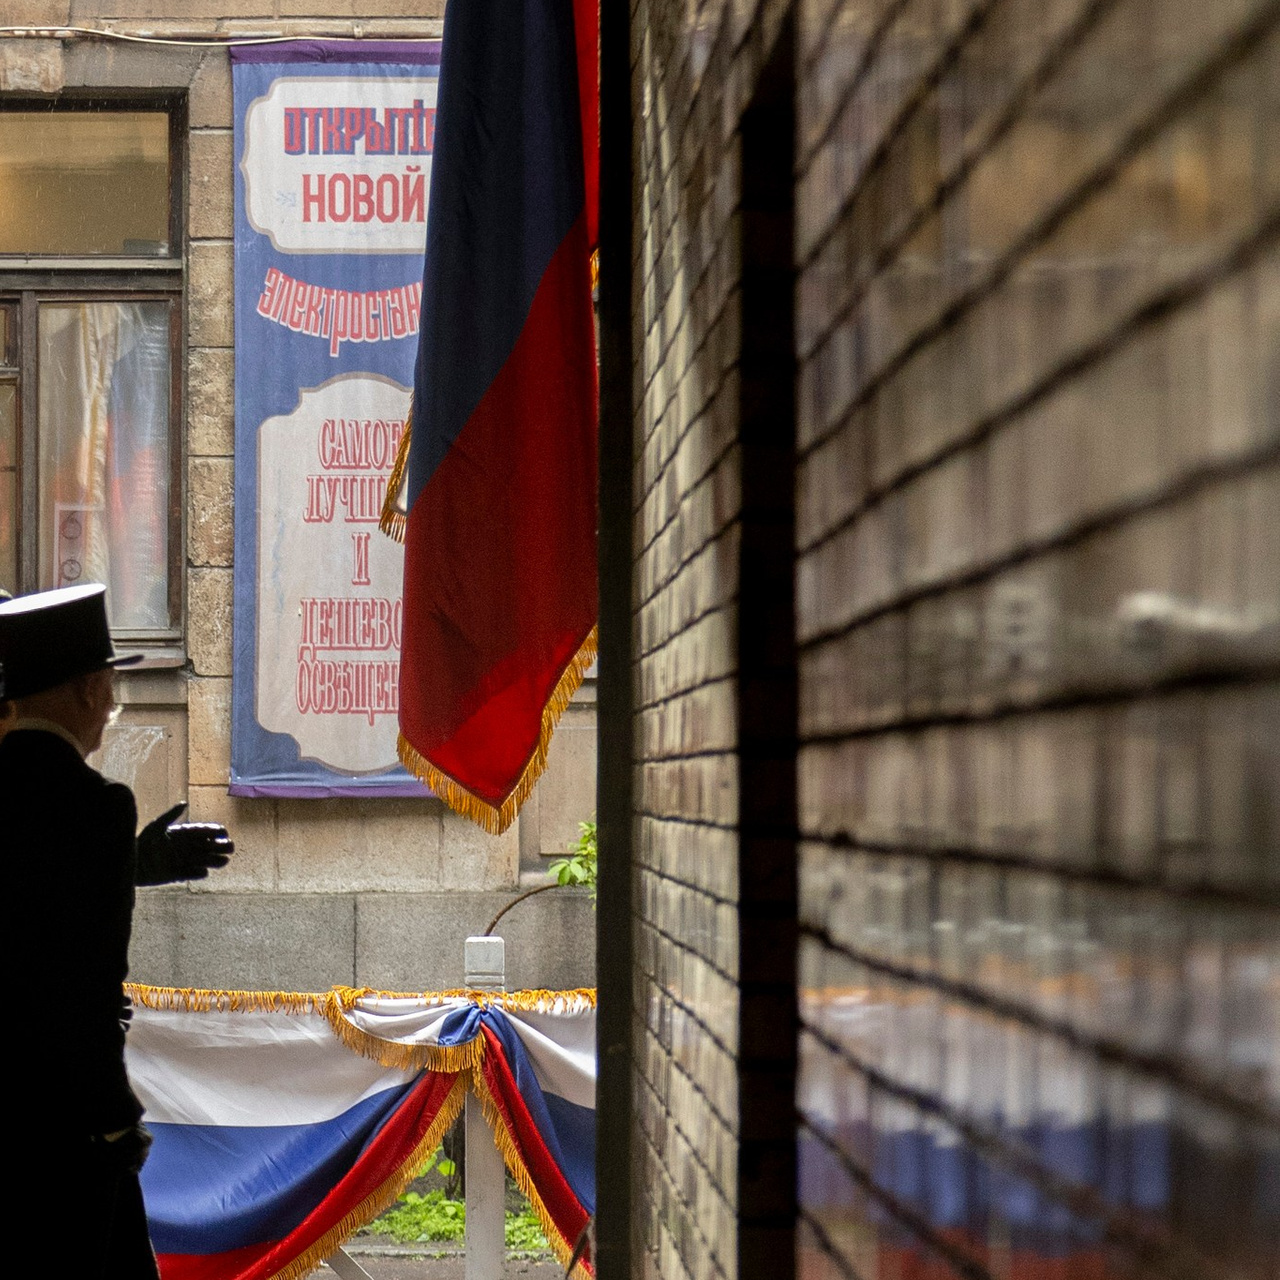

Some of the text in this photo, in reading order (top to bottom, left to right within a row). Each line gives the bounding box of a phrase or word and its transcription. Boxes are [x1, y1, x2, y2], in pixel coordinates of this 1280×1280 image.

[302, 165, 426, 223] НОВОЙ
[318, 419, 406, 470] САМОЕ
[303, 474, 391, 522] ЛУЧШ
[351, 532, 370, 585] И
